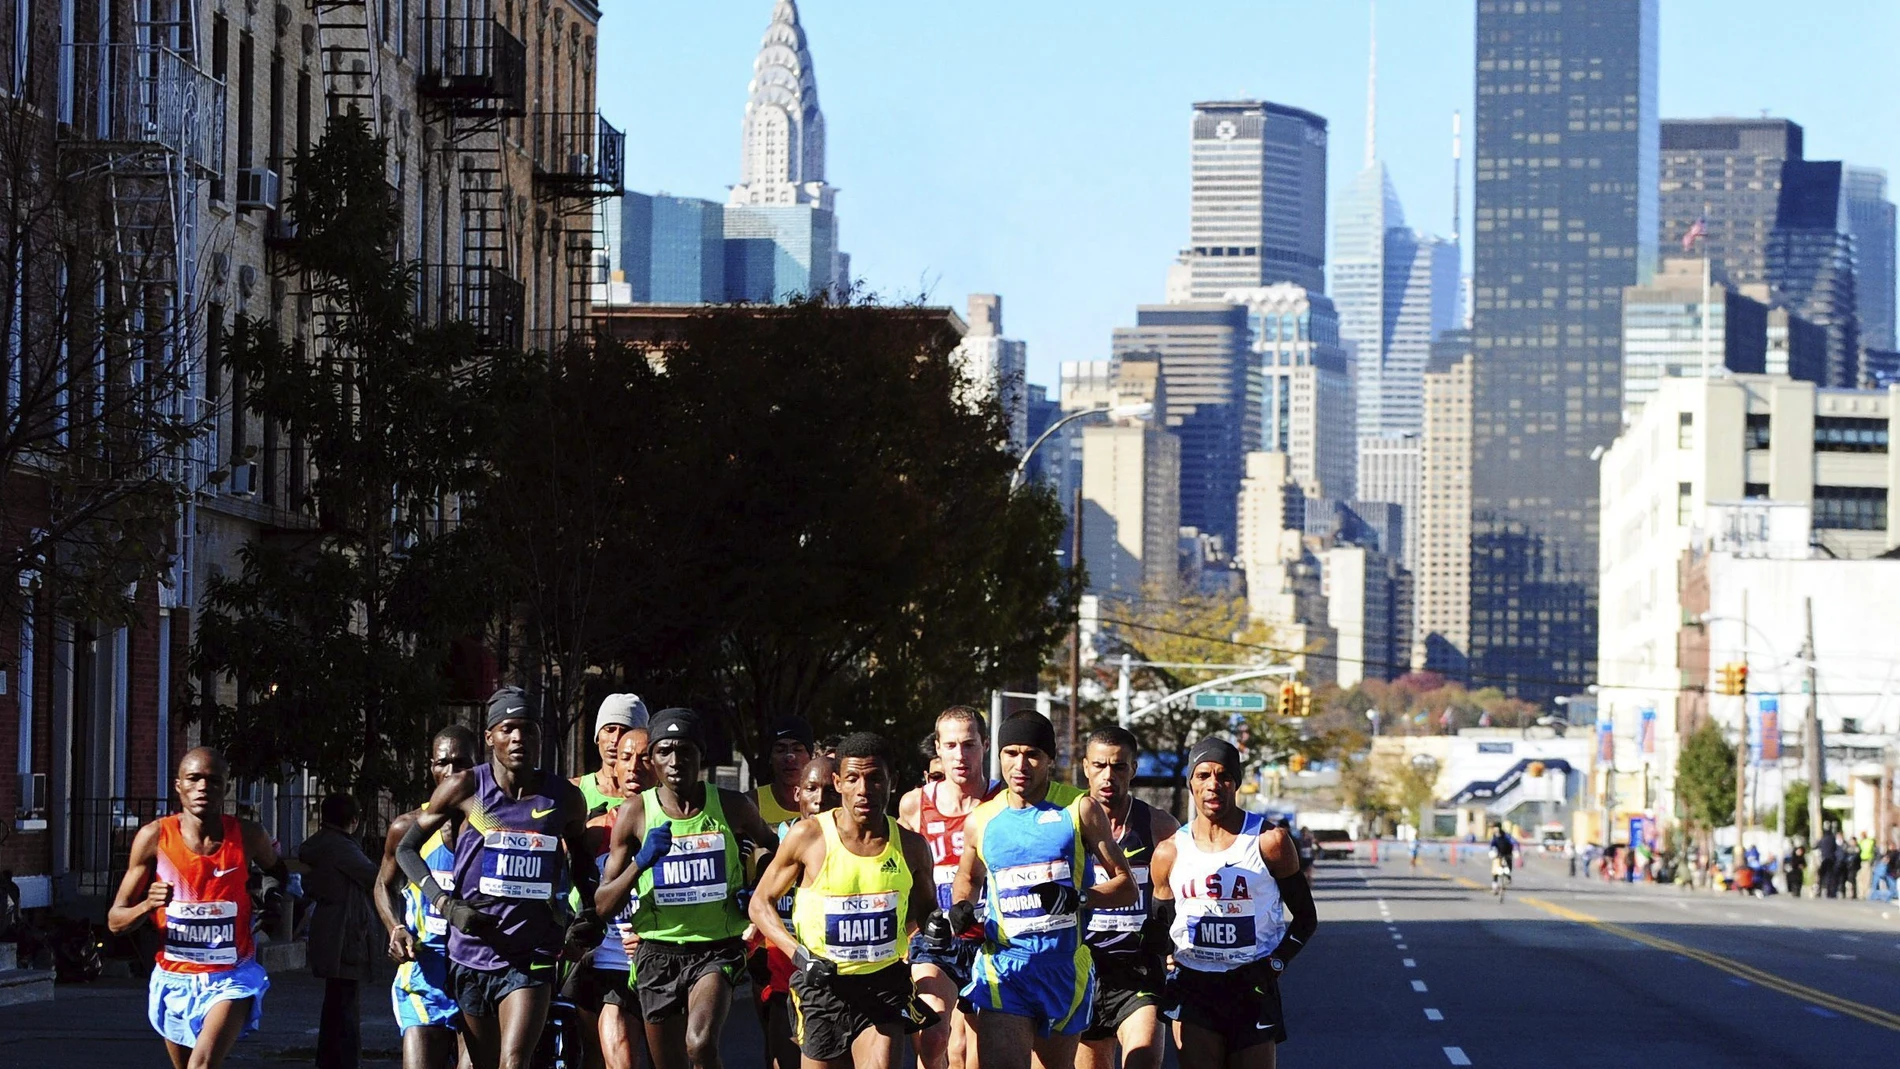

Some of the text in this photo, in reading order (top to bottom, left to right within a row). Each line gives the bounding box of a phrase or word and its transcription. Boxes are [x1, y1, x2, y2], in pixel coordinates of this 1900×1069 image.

[503, 836, 527, 847] ING
[672, 841, 693, 852] NG
[496, 853, 541, 878] KIRUI
[663, 858, 716, 885] MUTAI
[1011, 870, 1037, 882] ING
[1182, 873, 1249, 899] USA
[842, 900, 869, 910] ING
[838, 918, 888, 942] HAILE
[1201, 922, 1237, 945] MEB
